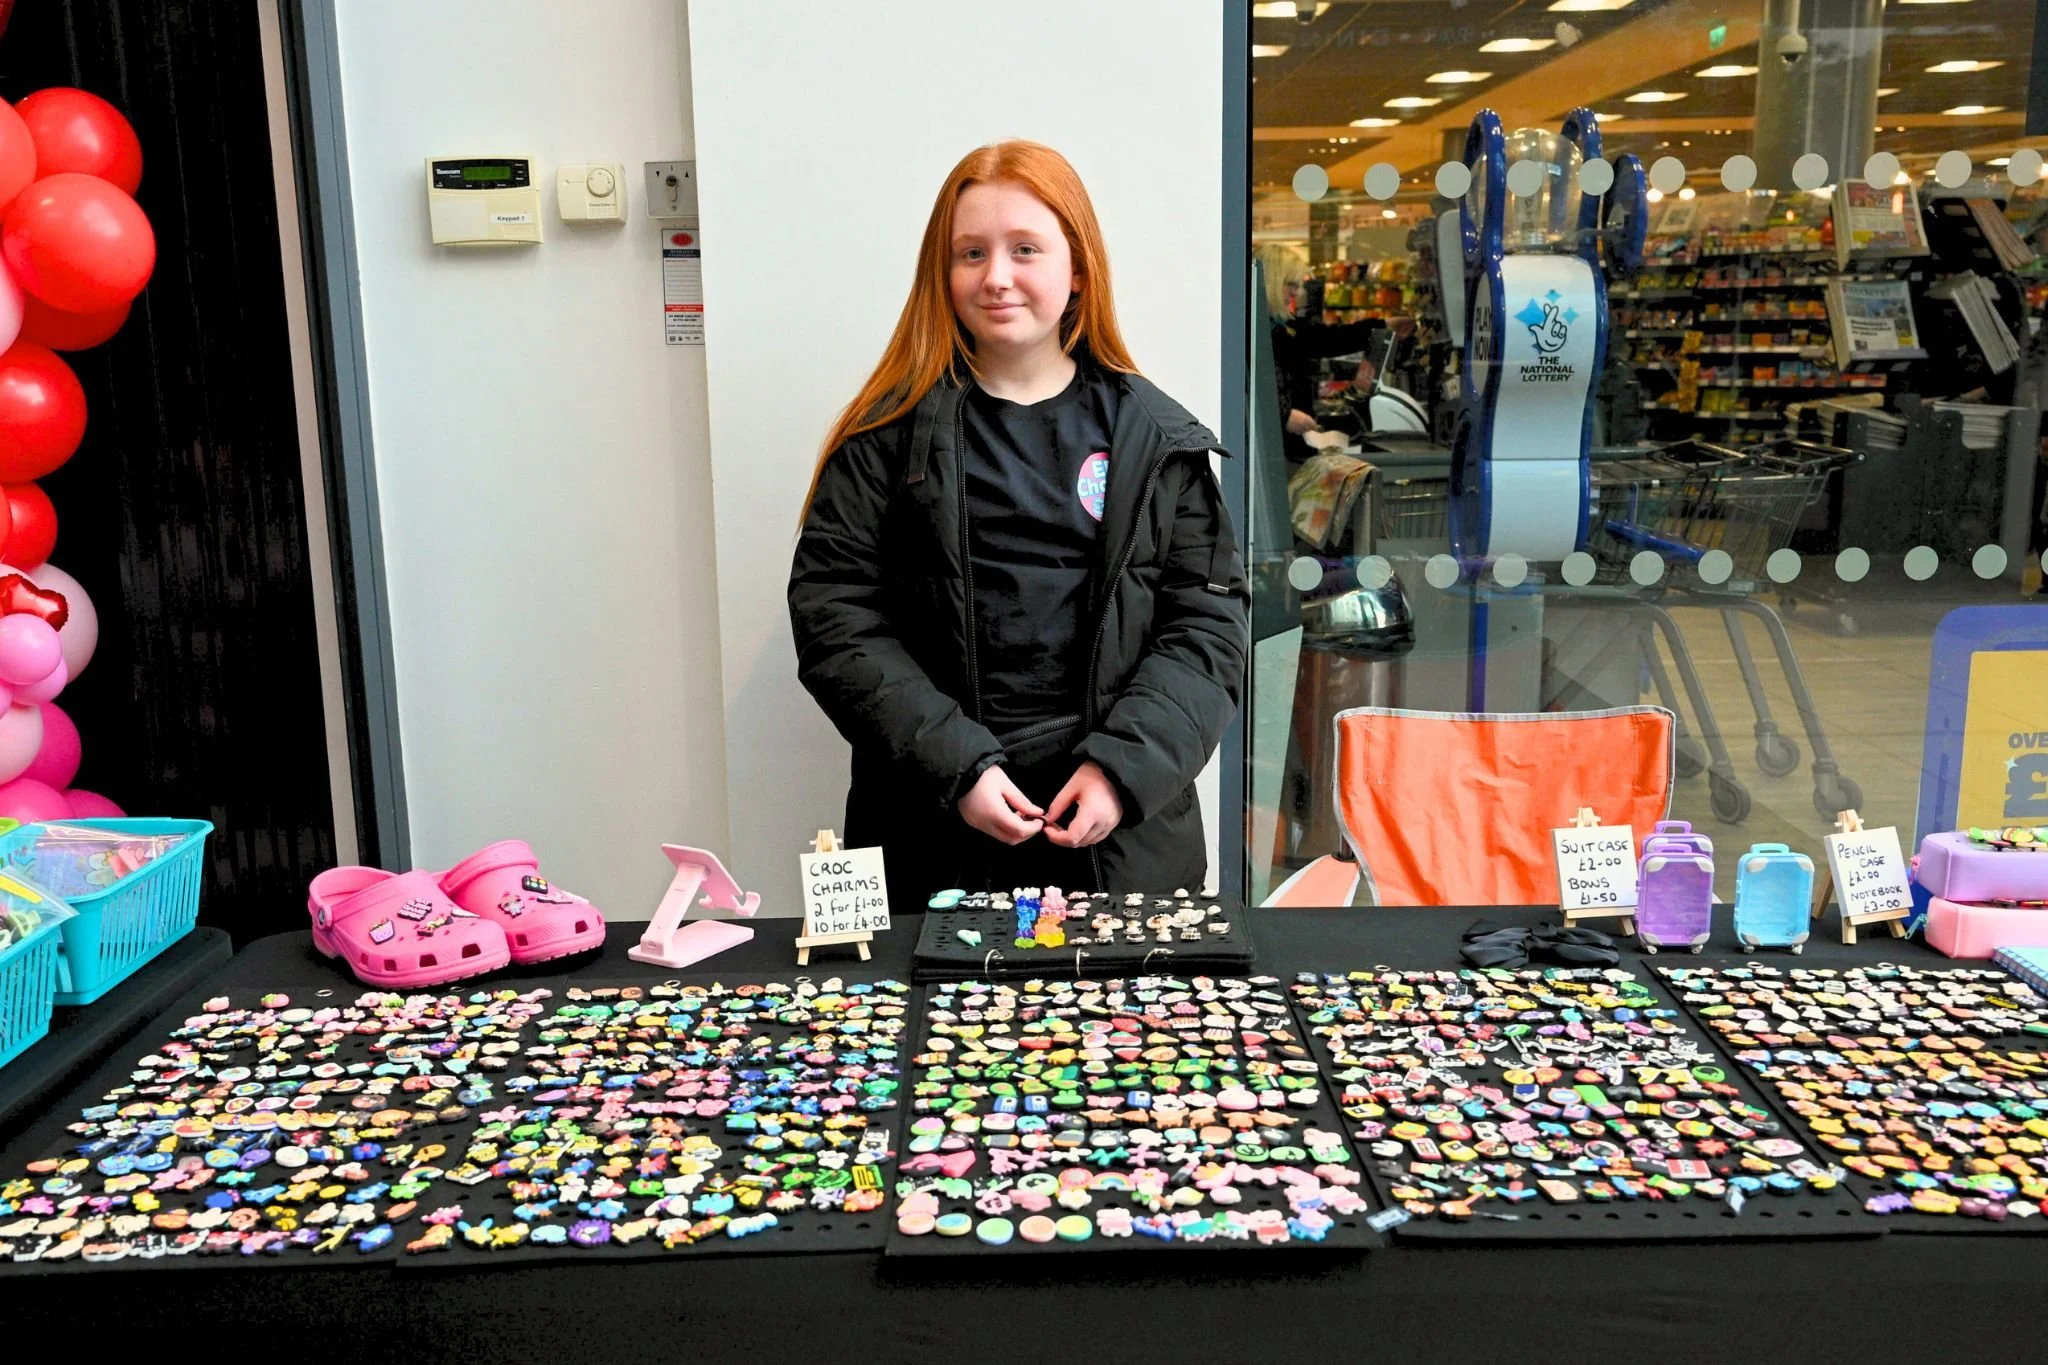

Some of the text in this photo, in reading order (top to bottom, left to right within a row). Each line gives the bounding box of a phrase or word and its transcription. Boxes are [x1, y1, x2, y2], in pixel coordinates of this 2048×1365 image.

[1538, 356, 1560, 365] THE
[1520, 365, 1575, 374] NATIONAL
[1522, 374, 1571, 382] LOTTERY
[1561, 839, 1629, 854] SUITCASE
[1838, 843, 1877, 859] PENCIL
[810, 860, 853, 877] CROC
[1860, 856, 1885, 868] CASE
[812, 876, 879, 896] CHARMS
[1850, 885, 1903, 902] NOTEBOOK
[814, 902, 824, 917] 2
[830, 898, 850, 916] for
[815, 921, 829, 933] 10
[832, 918, 850, 932] for
